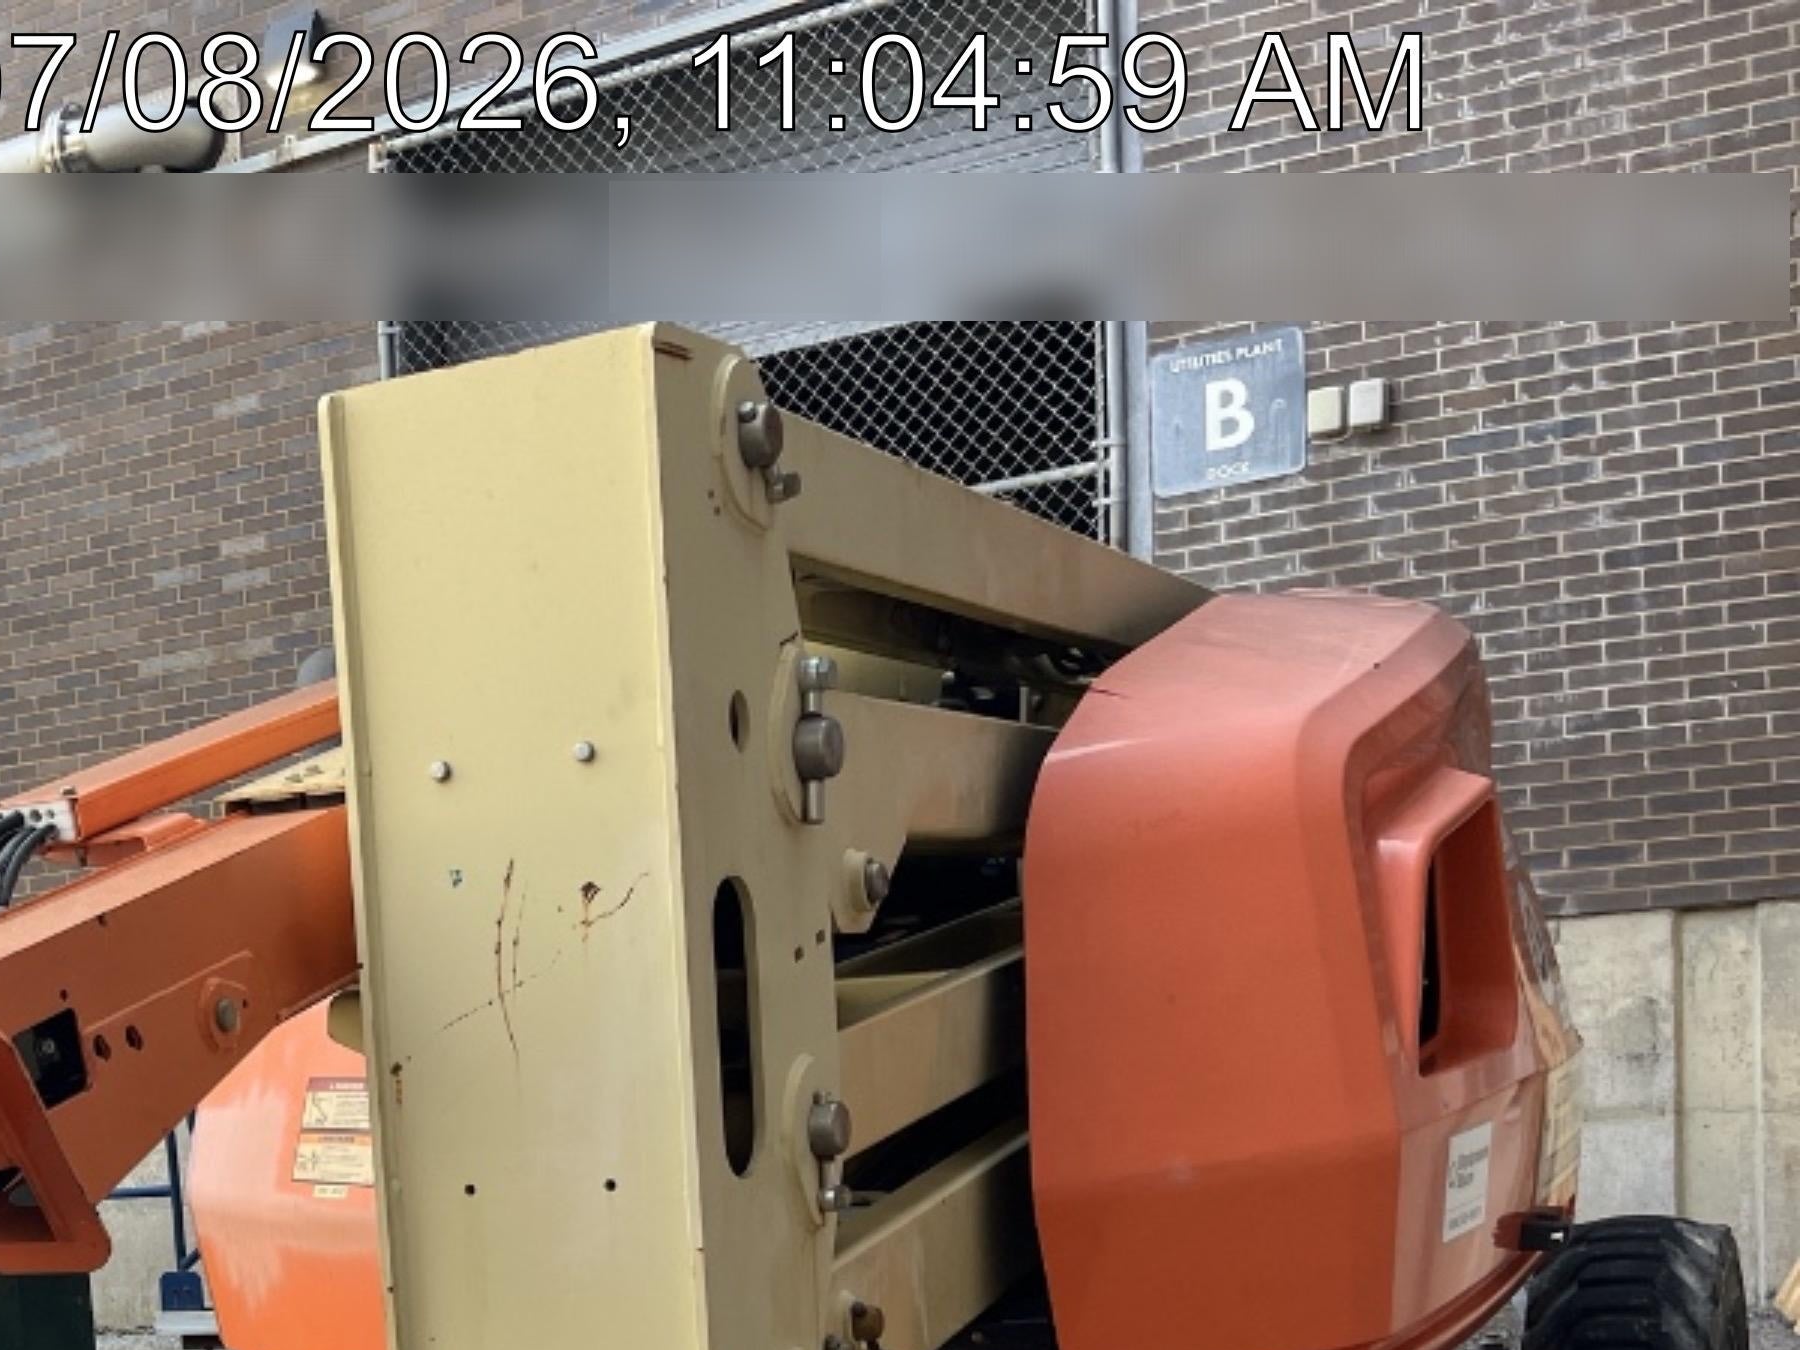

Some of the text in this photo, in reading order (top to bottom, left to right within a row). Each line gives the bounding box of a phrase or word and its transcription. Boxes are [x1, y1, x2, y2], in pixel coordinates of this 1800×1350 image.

[1170, 338, 1283, 373] UTILITIES PLANT
[1204, 377, 1255, 452] B
